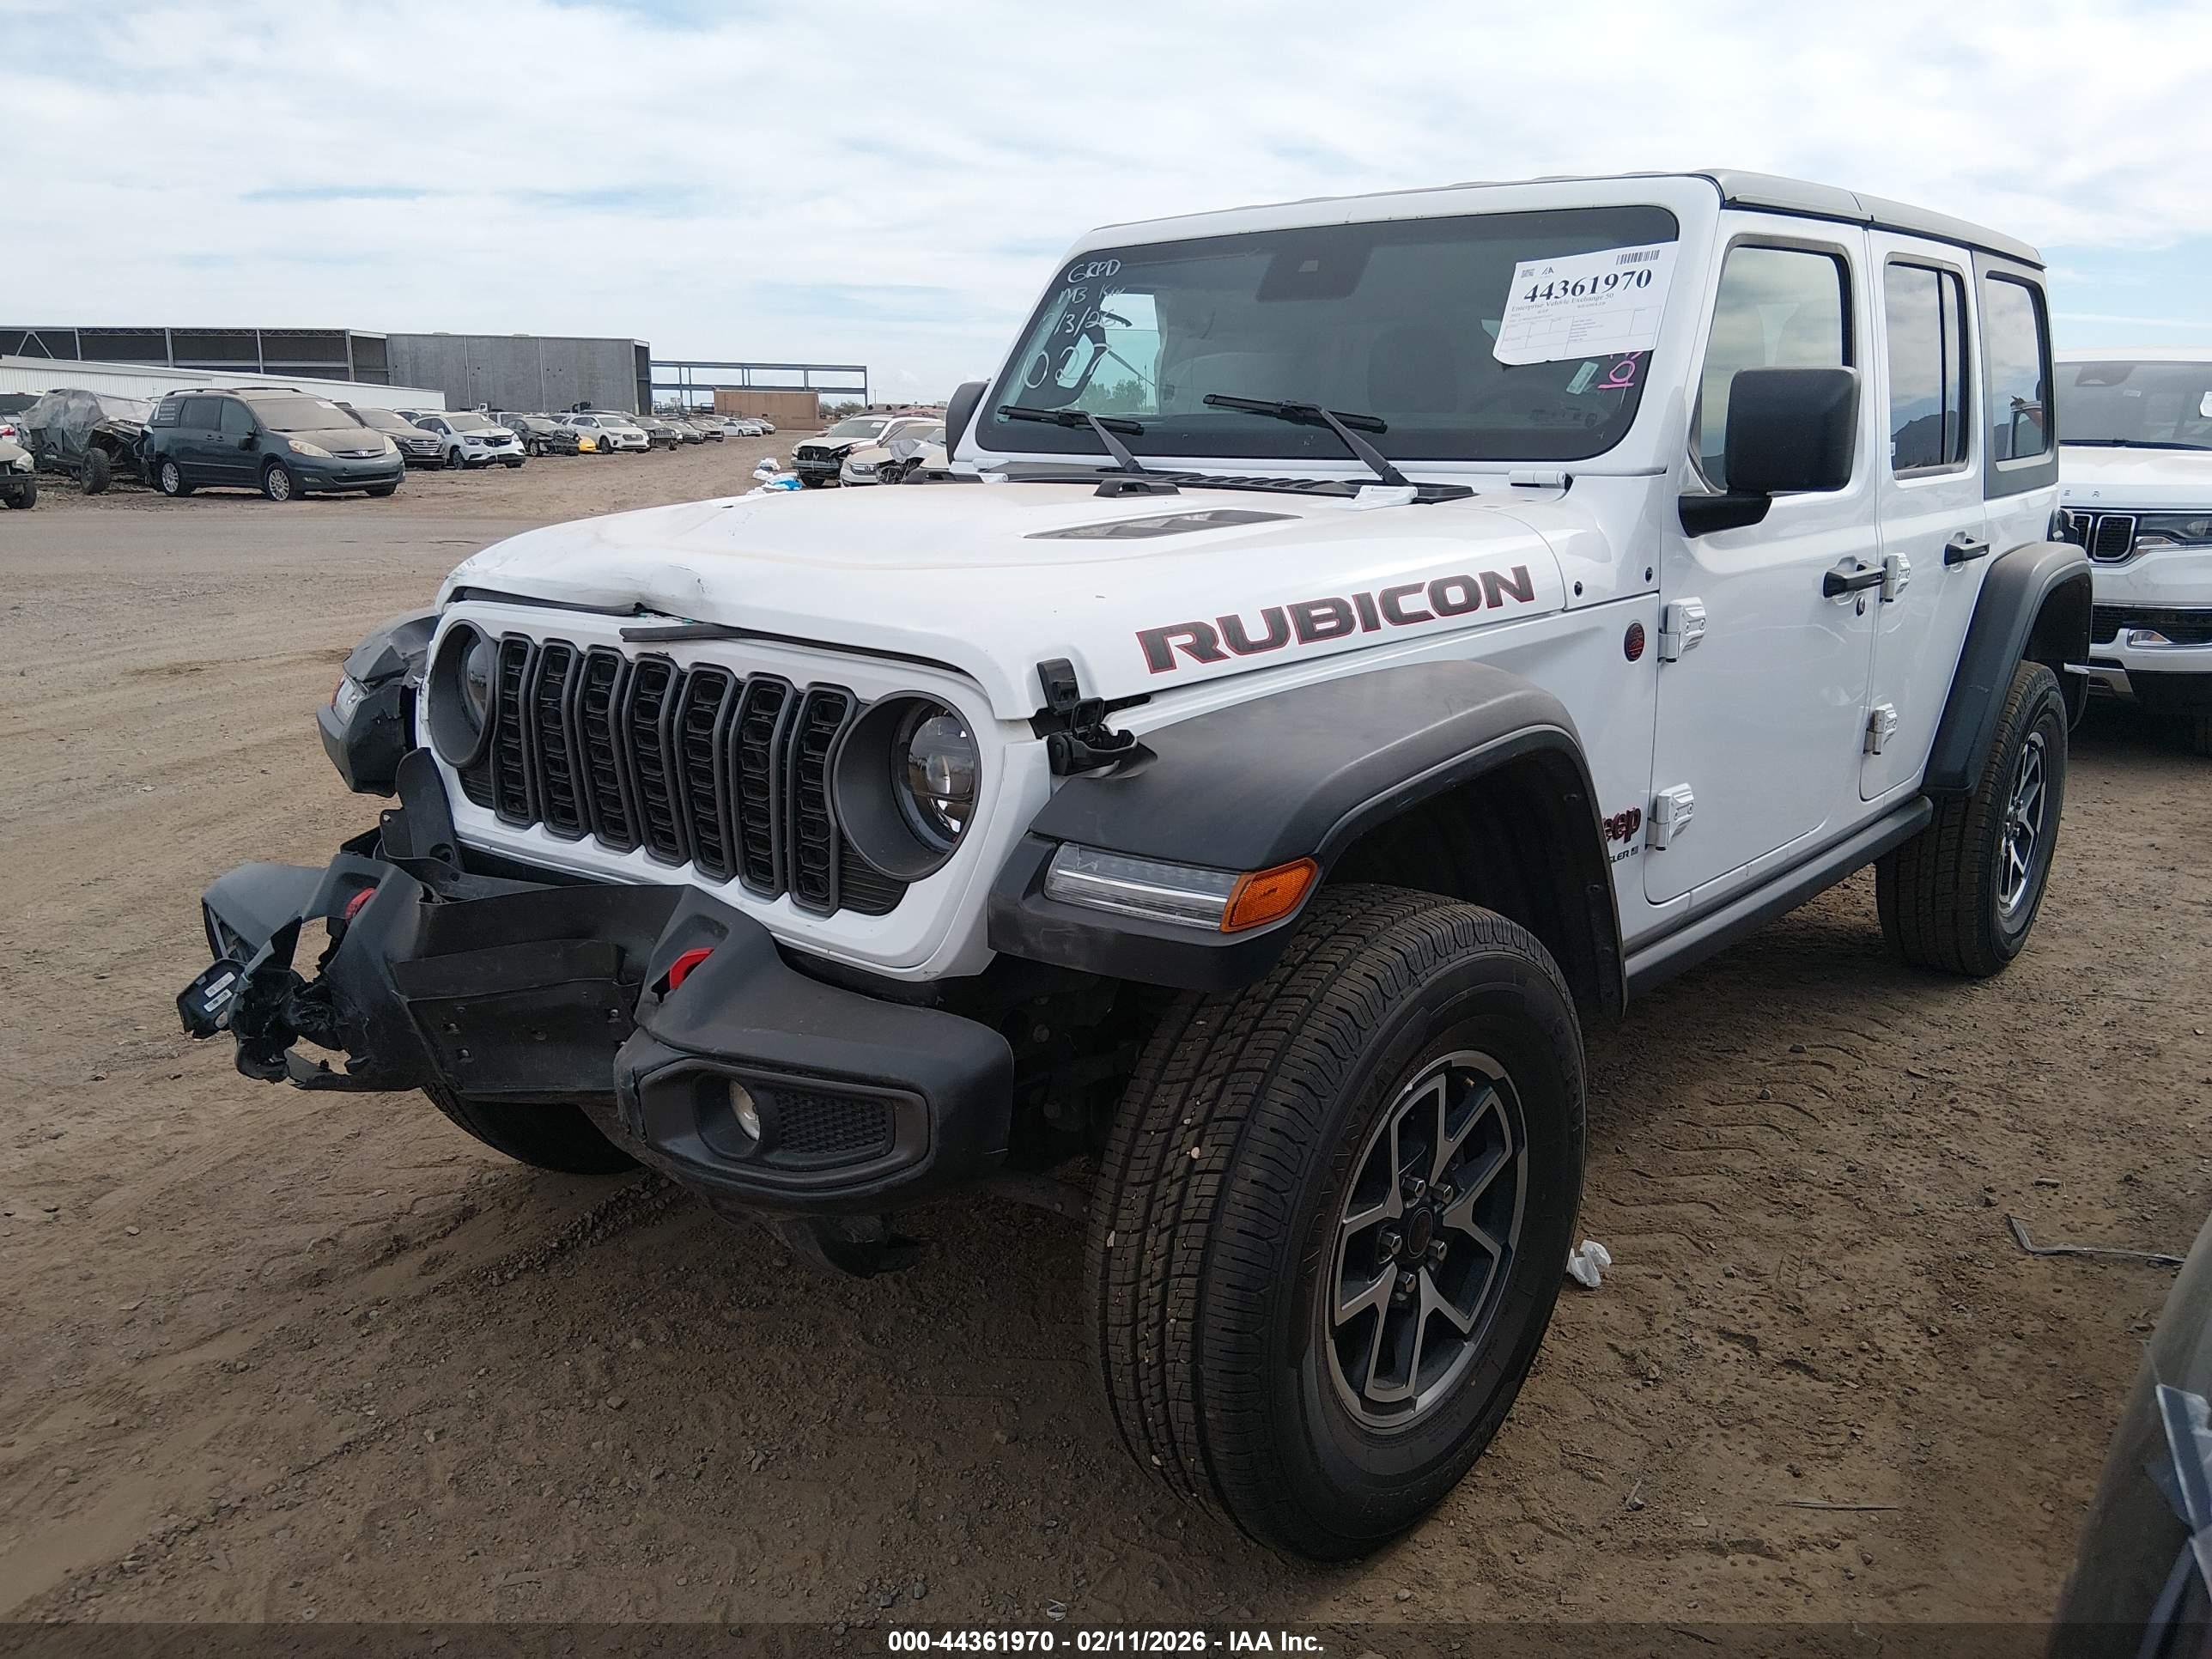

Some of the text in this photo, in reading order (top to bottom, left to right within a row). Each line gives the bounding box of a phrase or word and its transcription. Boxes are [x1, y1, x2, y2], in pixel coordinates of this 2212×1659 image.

[1523, 269, 1652, 303] 44361970
[1546, 298, 1569, 307] Vehicle
[1134, 564, 1535, 674] RUBICON
[1604, 807, 1641, 844] eep
